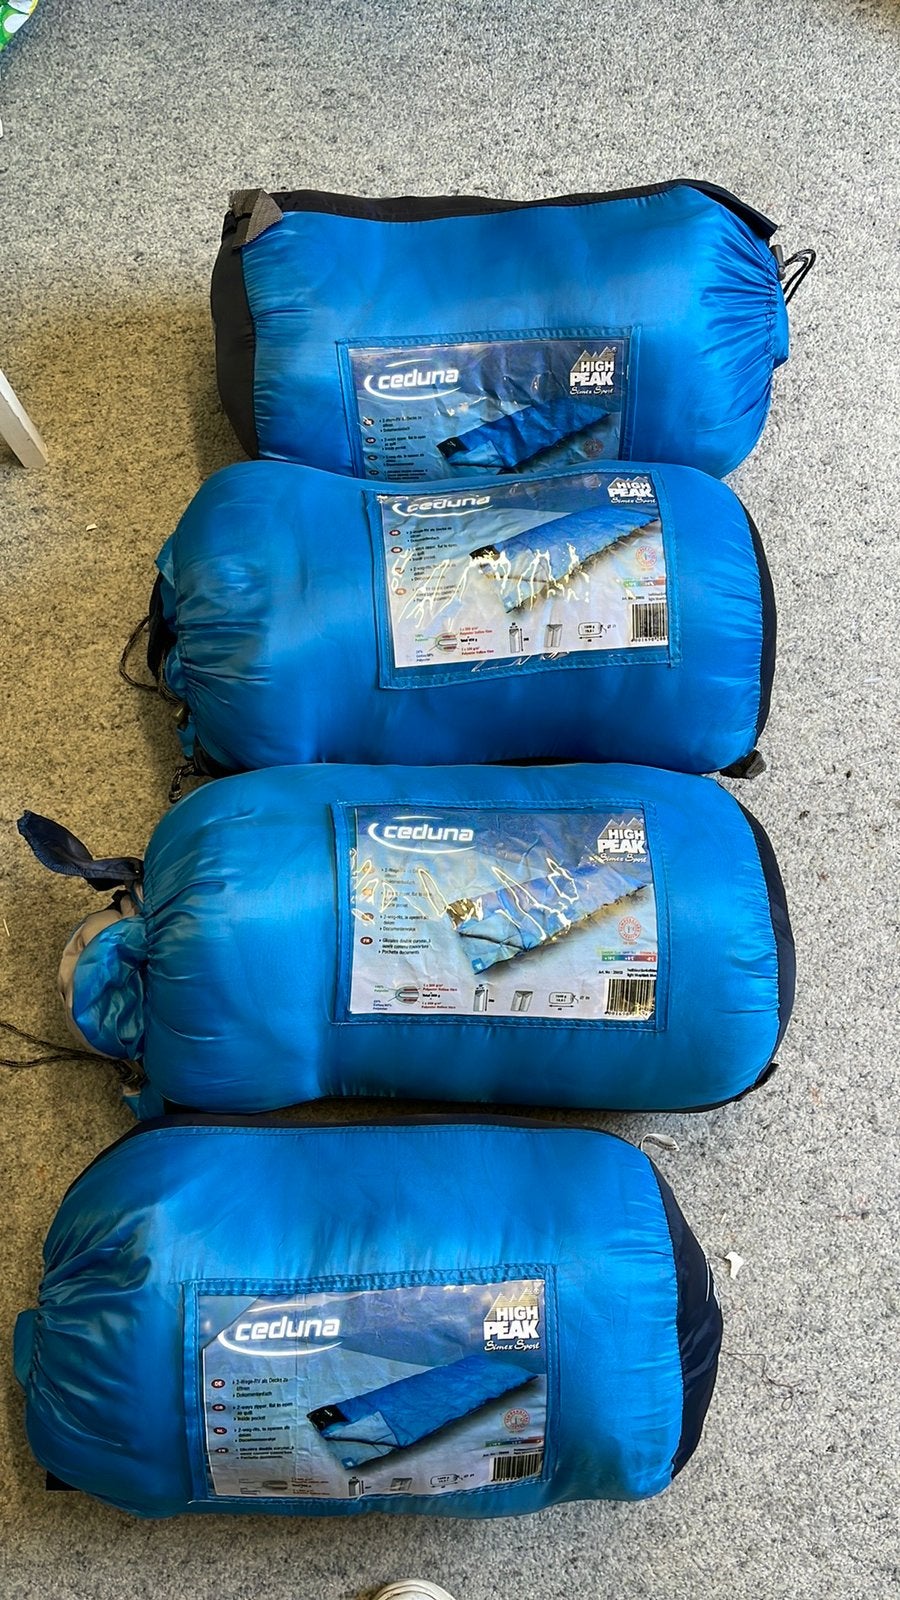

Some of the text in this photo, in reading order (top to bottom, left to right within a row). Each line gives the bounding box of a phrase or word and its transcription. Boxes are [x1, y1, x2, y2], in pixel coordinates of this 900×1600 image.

[580, 360, 615, 372] HIGH
[378, 368, 459, 389] ceduna
[570, 371, 614, 386] PEAK
[608, 488, 654, 498] PEAK
[407, 496, 490, 513] ceduna
[384, 823, 474, 842] ceduna
[608, 829, 645, 840] HIGH
[597, 838, 647, 854] PEAK
[496, 1305, 539, 1321] HIGH
[235, 1316, 340, 1341] ceduna
[483, 1319, 540, 1340] PEAK
[514, 1339, 540, 1351] Sport
